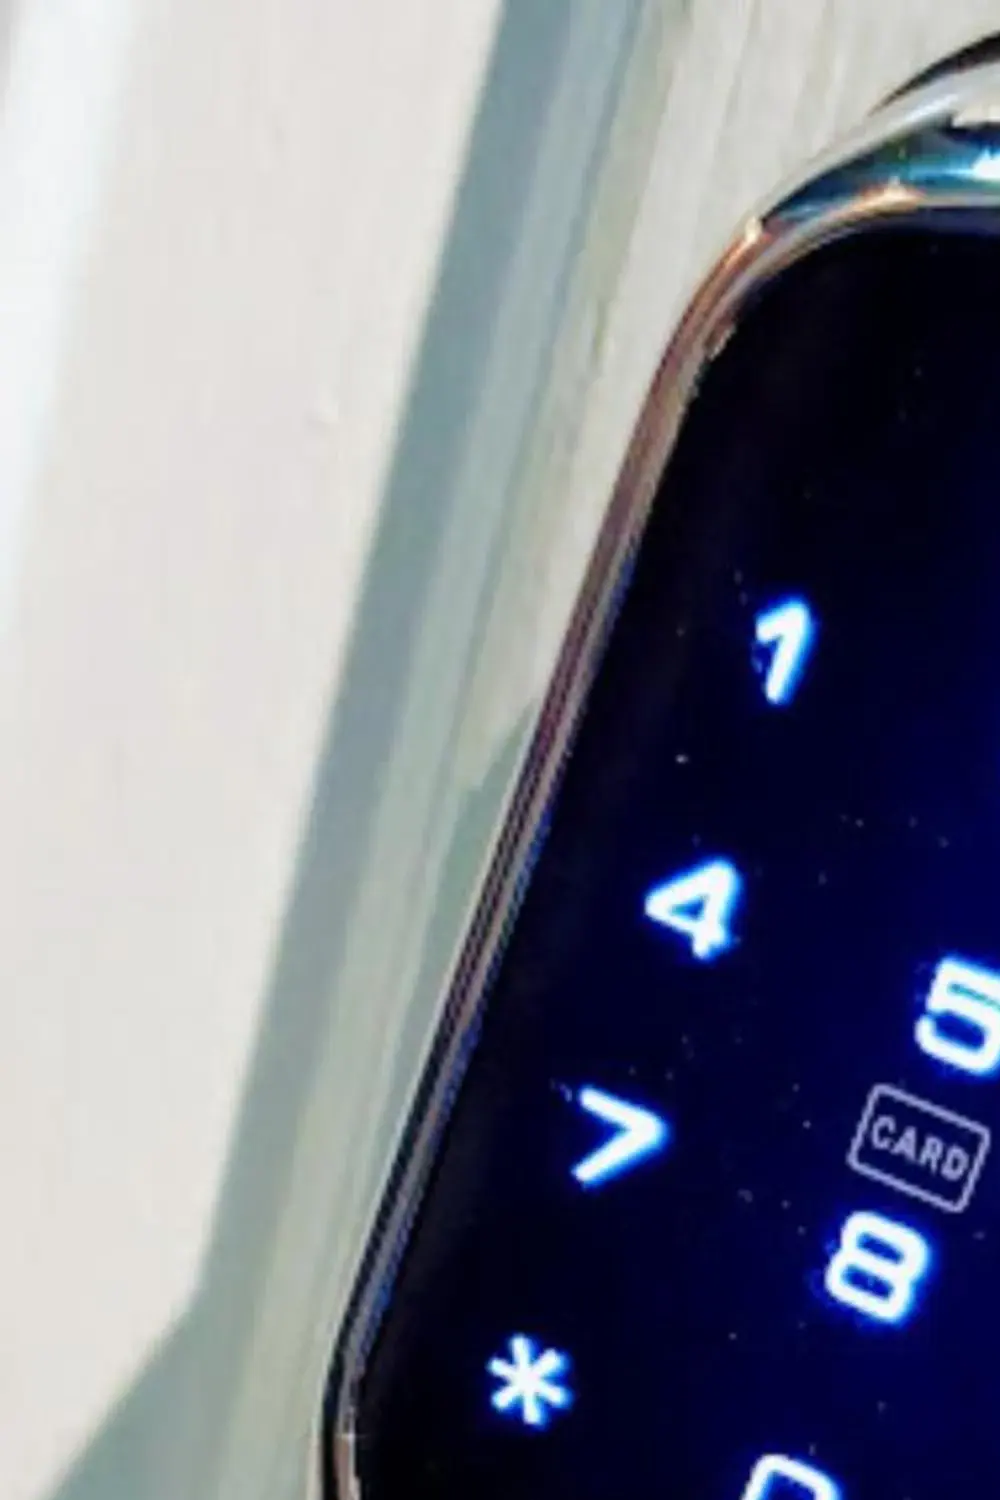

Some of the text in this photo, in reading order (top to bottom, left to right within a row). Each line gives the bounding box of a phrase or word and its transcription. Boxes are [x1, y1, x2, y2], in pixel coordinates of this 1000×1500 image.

[757, 600, 814, 704] 1
[645, 860, 740, 959] 4
[871, 1114, 971, 1182] CARD
[574, 1088, 667, 1183] 7
[825, 1212, 930, 1323] 8
